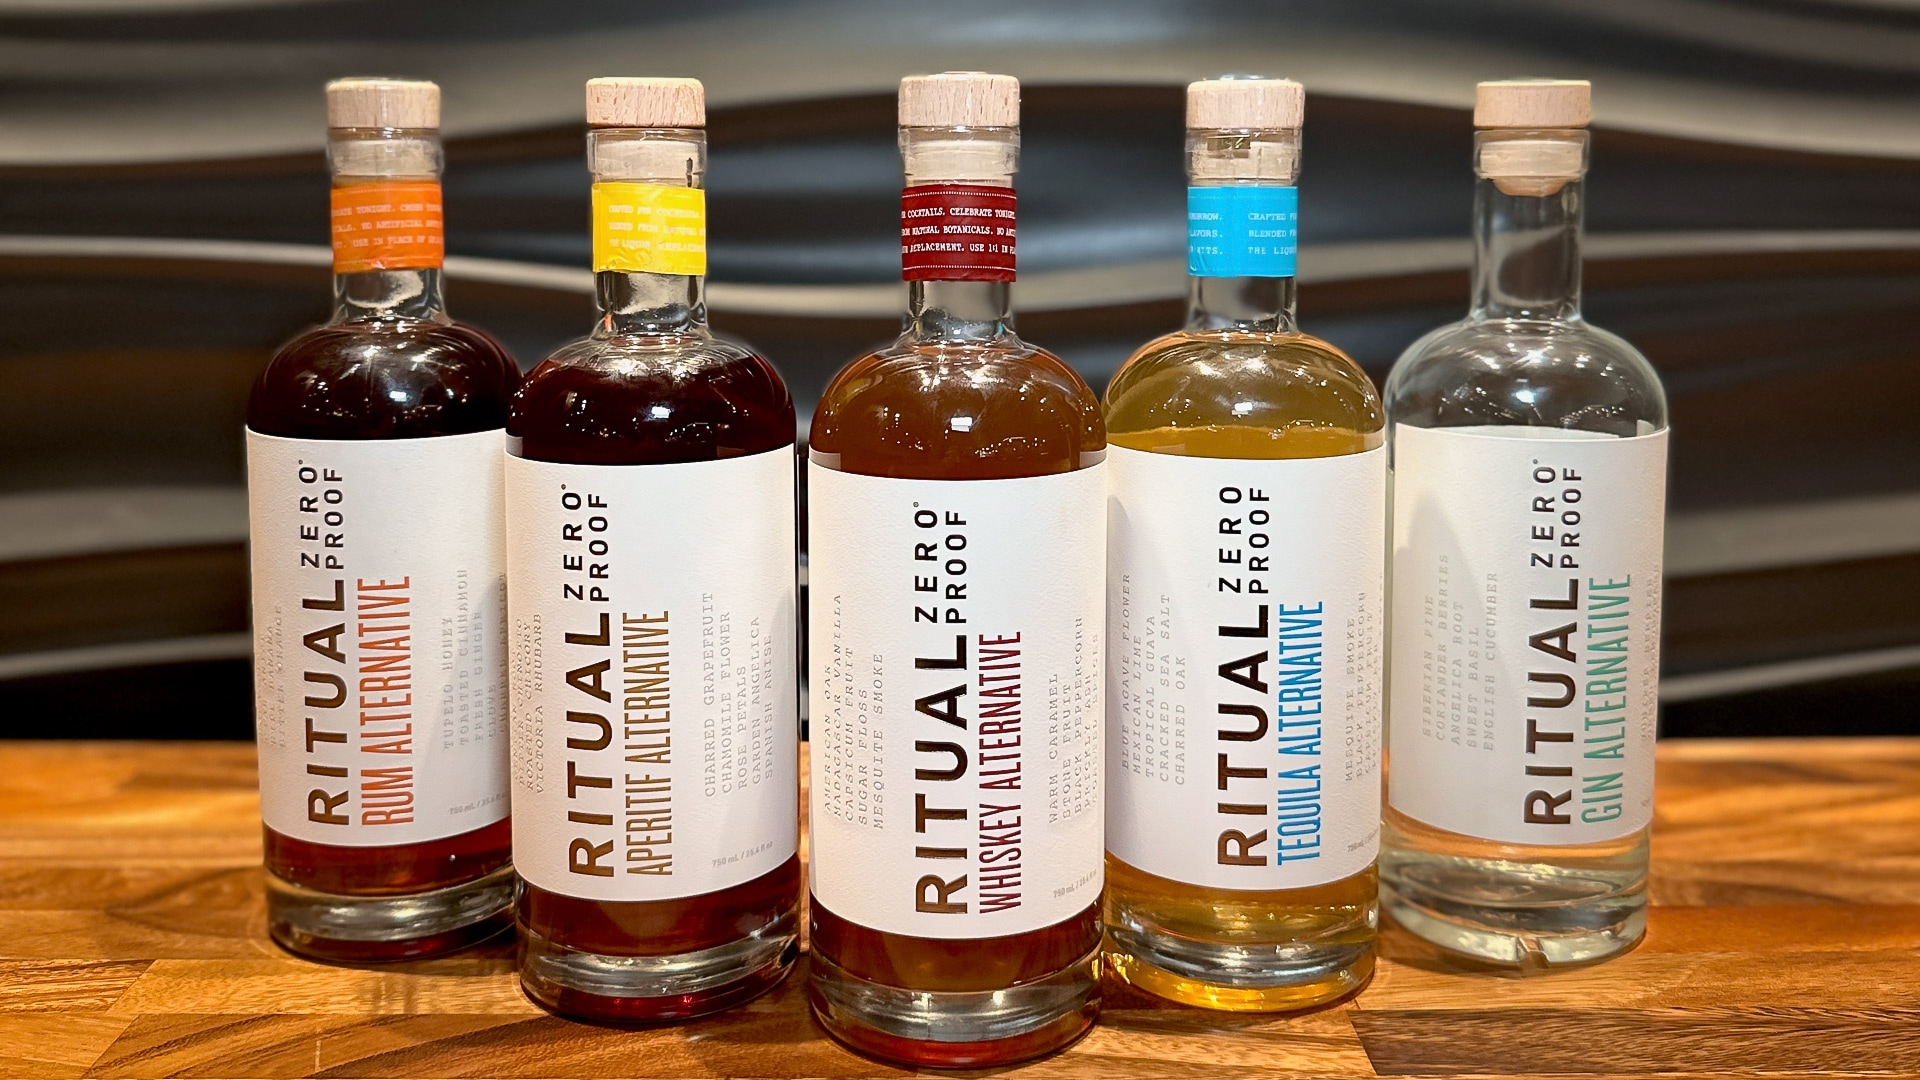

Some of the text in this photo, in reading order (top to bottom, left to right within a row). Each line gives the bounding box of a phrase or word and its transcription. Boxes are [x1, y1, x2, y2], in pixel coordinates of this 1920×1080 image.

[907, 207, 946, 218] COCKTAILS.
[949, 207, 993, 217] CELEBRATE
[910, 243, 965, 253] REPLACEMENT.
[969, 244, 985, 253] USE
[988, 244, 999, 253] 1:1
[912, 226, 940, 236] NATURAL
[943, 225, 994, 235] BOTANICALS.
[997, 227, 1005, 236] NO
[1248, 212, 1287, 221] CRAFTED
[1248, 229, 1287, 238] BLENDED
[1248, 247, 1267, 255] THE
[298, 466, 320, 569] ZERO
[323, 466, 345, 570] PROOF
[562, 491, 584, 602] ZERO
[587, 493, 610, 603] PROOF
[914, 509, 938, 624] ZERO
[944, 510, 968, 625] PROOF
[1218, 485, 1242, 593] ZERO
[1248, 486, 1270, 594] PROOF
[1530, 465, 1557, 569] ZERO
[1560, 467, 1582, 570] PROOF
[301, 578, 350, 827] RITUAL
[356, 576, 415, 827] RUM ALTERNATIVE
[441, 617, 454, 749] TUPELO HONEY
[456, 569, 469, 746] TOASTED CINNAMON
[473, 611, 483, 742] FRESH GINGER
[488, 684, 497, 738] CLOVE
[523, 622, 534, 791] ROASTED CHICORY
[533, 614, 544, 794] VICTORIA RHUBARB
[702, 592, 716, 797] CHARRED GRAPEFRUIT
[720, 611, 733, 794] CHAMOMILE FLOWER
[750, 616, 761, 785] GARDEN ANGELICA
[763, 635, 773, 779] SPANISH ANISE
[833, 594, 841, 818] MADAGASCAR VANILLA
[1074, 616, 1083, 815] BLACK PEPPERCORN
[1122, 573, 1130, 770] BLUE AGAVE FLOWER
[1133, 635, 1142, 775] MEXICAN LIME
[1145, 615, 1155, 778] TROPICAL GUAVA
[1160, 594, 1170, 783] CRACKED SEA SALT
[1422, 594, 1433, 738] SIBERIAN PINE
[1436, 554, 1449, 741] CORIANDER BERRIES
[1451, 601, 1463, 746] ANGELICA ROOT
[1466, 627, 1479, 748] SWEET BASIL
[1483, 572, 1497, 752] ENGLISH CUCUMBER
[1523, 578, 1579, 825] RITUAL
[1580, 573, 1632, 824] GIN ALTERNATIVE
[563, 611, 615, 879] RITUAL
[621, 611, 673, 877] APERITIF ALTERNATIVE
[736, 665, 748, 789] ROSE PETALS
[845, 647, 854, 822] CAPSICUM FRUIT
[858, 688, 868, 826] SUGAR FLOSS
[873, 653, 885, 830] MESQUITE SMOKE
[913, 634, 968, 915] RITUAL
[978, 631, 1023, 915] WHISKEY ALTERNATIVE
[1048, 673, 1058, 824] WARM CARAMEL
[1062, 683, 1071, 819] STONE FRUIT
[1175, 656, 1186, 786] CHARRED OAK
[1217, 604, 1269, 868] RITUAL
[1276, 600, 1323, 866] TEQUILA ALTERNATIVE
[711, 857, 727, 868] 750
